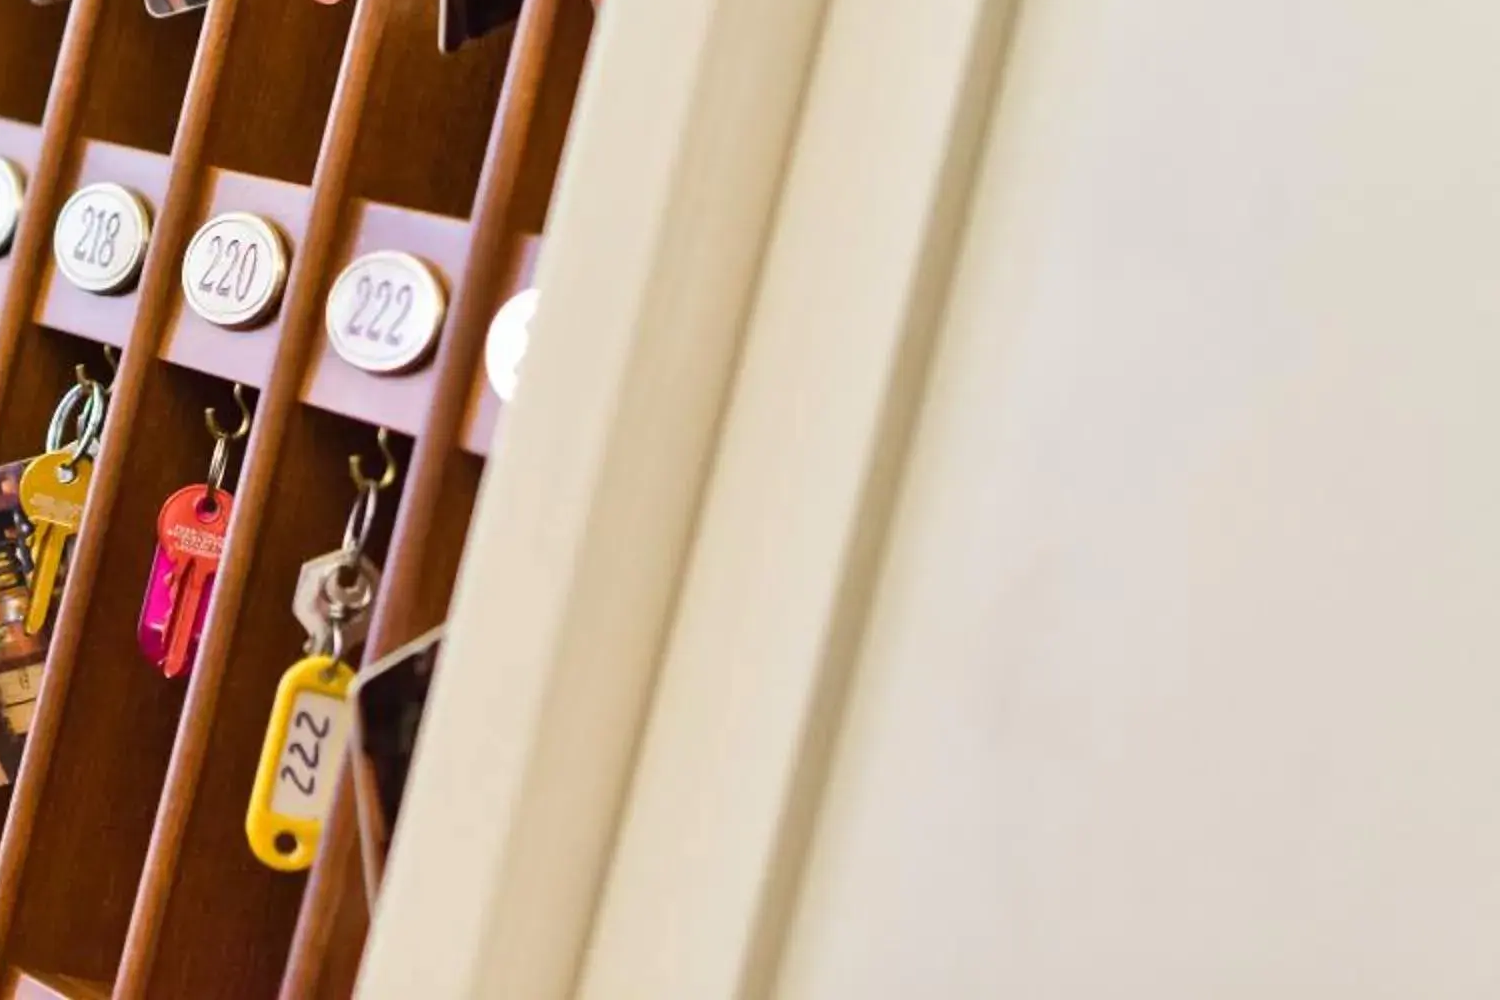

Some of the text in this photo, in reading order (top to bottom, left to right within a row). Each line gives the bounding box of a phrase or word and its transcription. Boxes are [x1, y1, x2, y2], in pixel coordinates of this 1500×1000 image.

[73, 205, 121, 268] 218
[198, 235, 258, 302] 220
[347, 272, 414, 346] 222
[280, 710, 331, 797] 222
